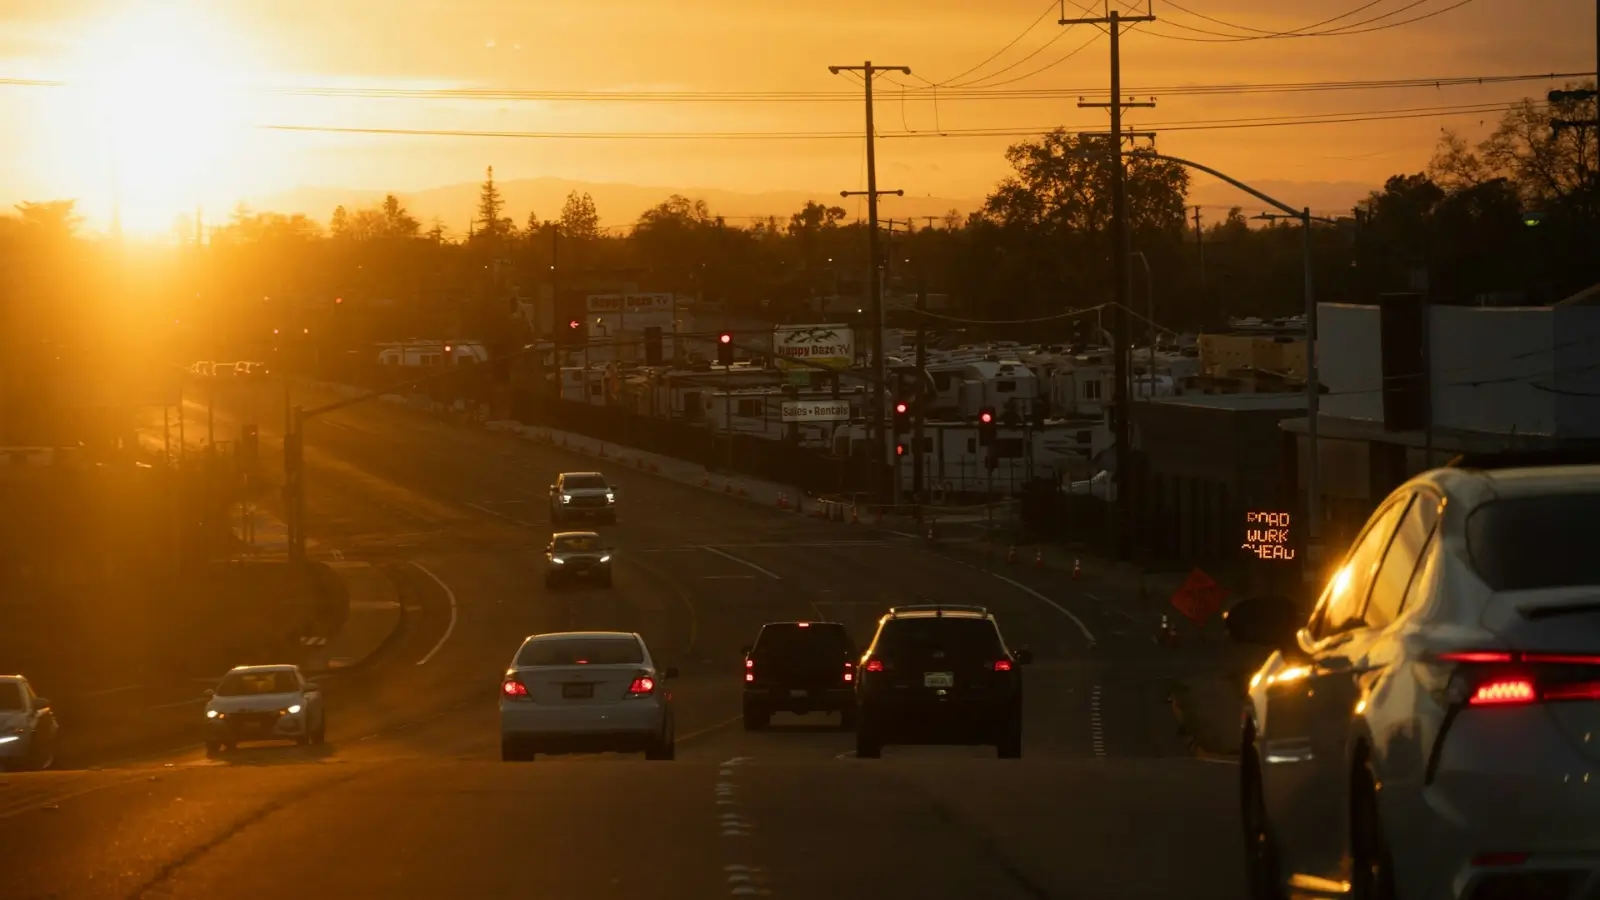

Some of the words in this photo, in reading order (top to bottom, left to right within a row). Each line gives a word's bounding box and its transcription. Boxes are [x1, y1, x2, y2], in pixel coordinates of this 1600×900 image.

[778, 346, 810, 357] Happy
[811, 345, 835, 355] Daze
[783, 406, 807, 417] Sales
[814, 405, 849, 416] Rentals
